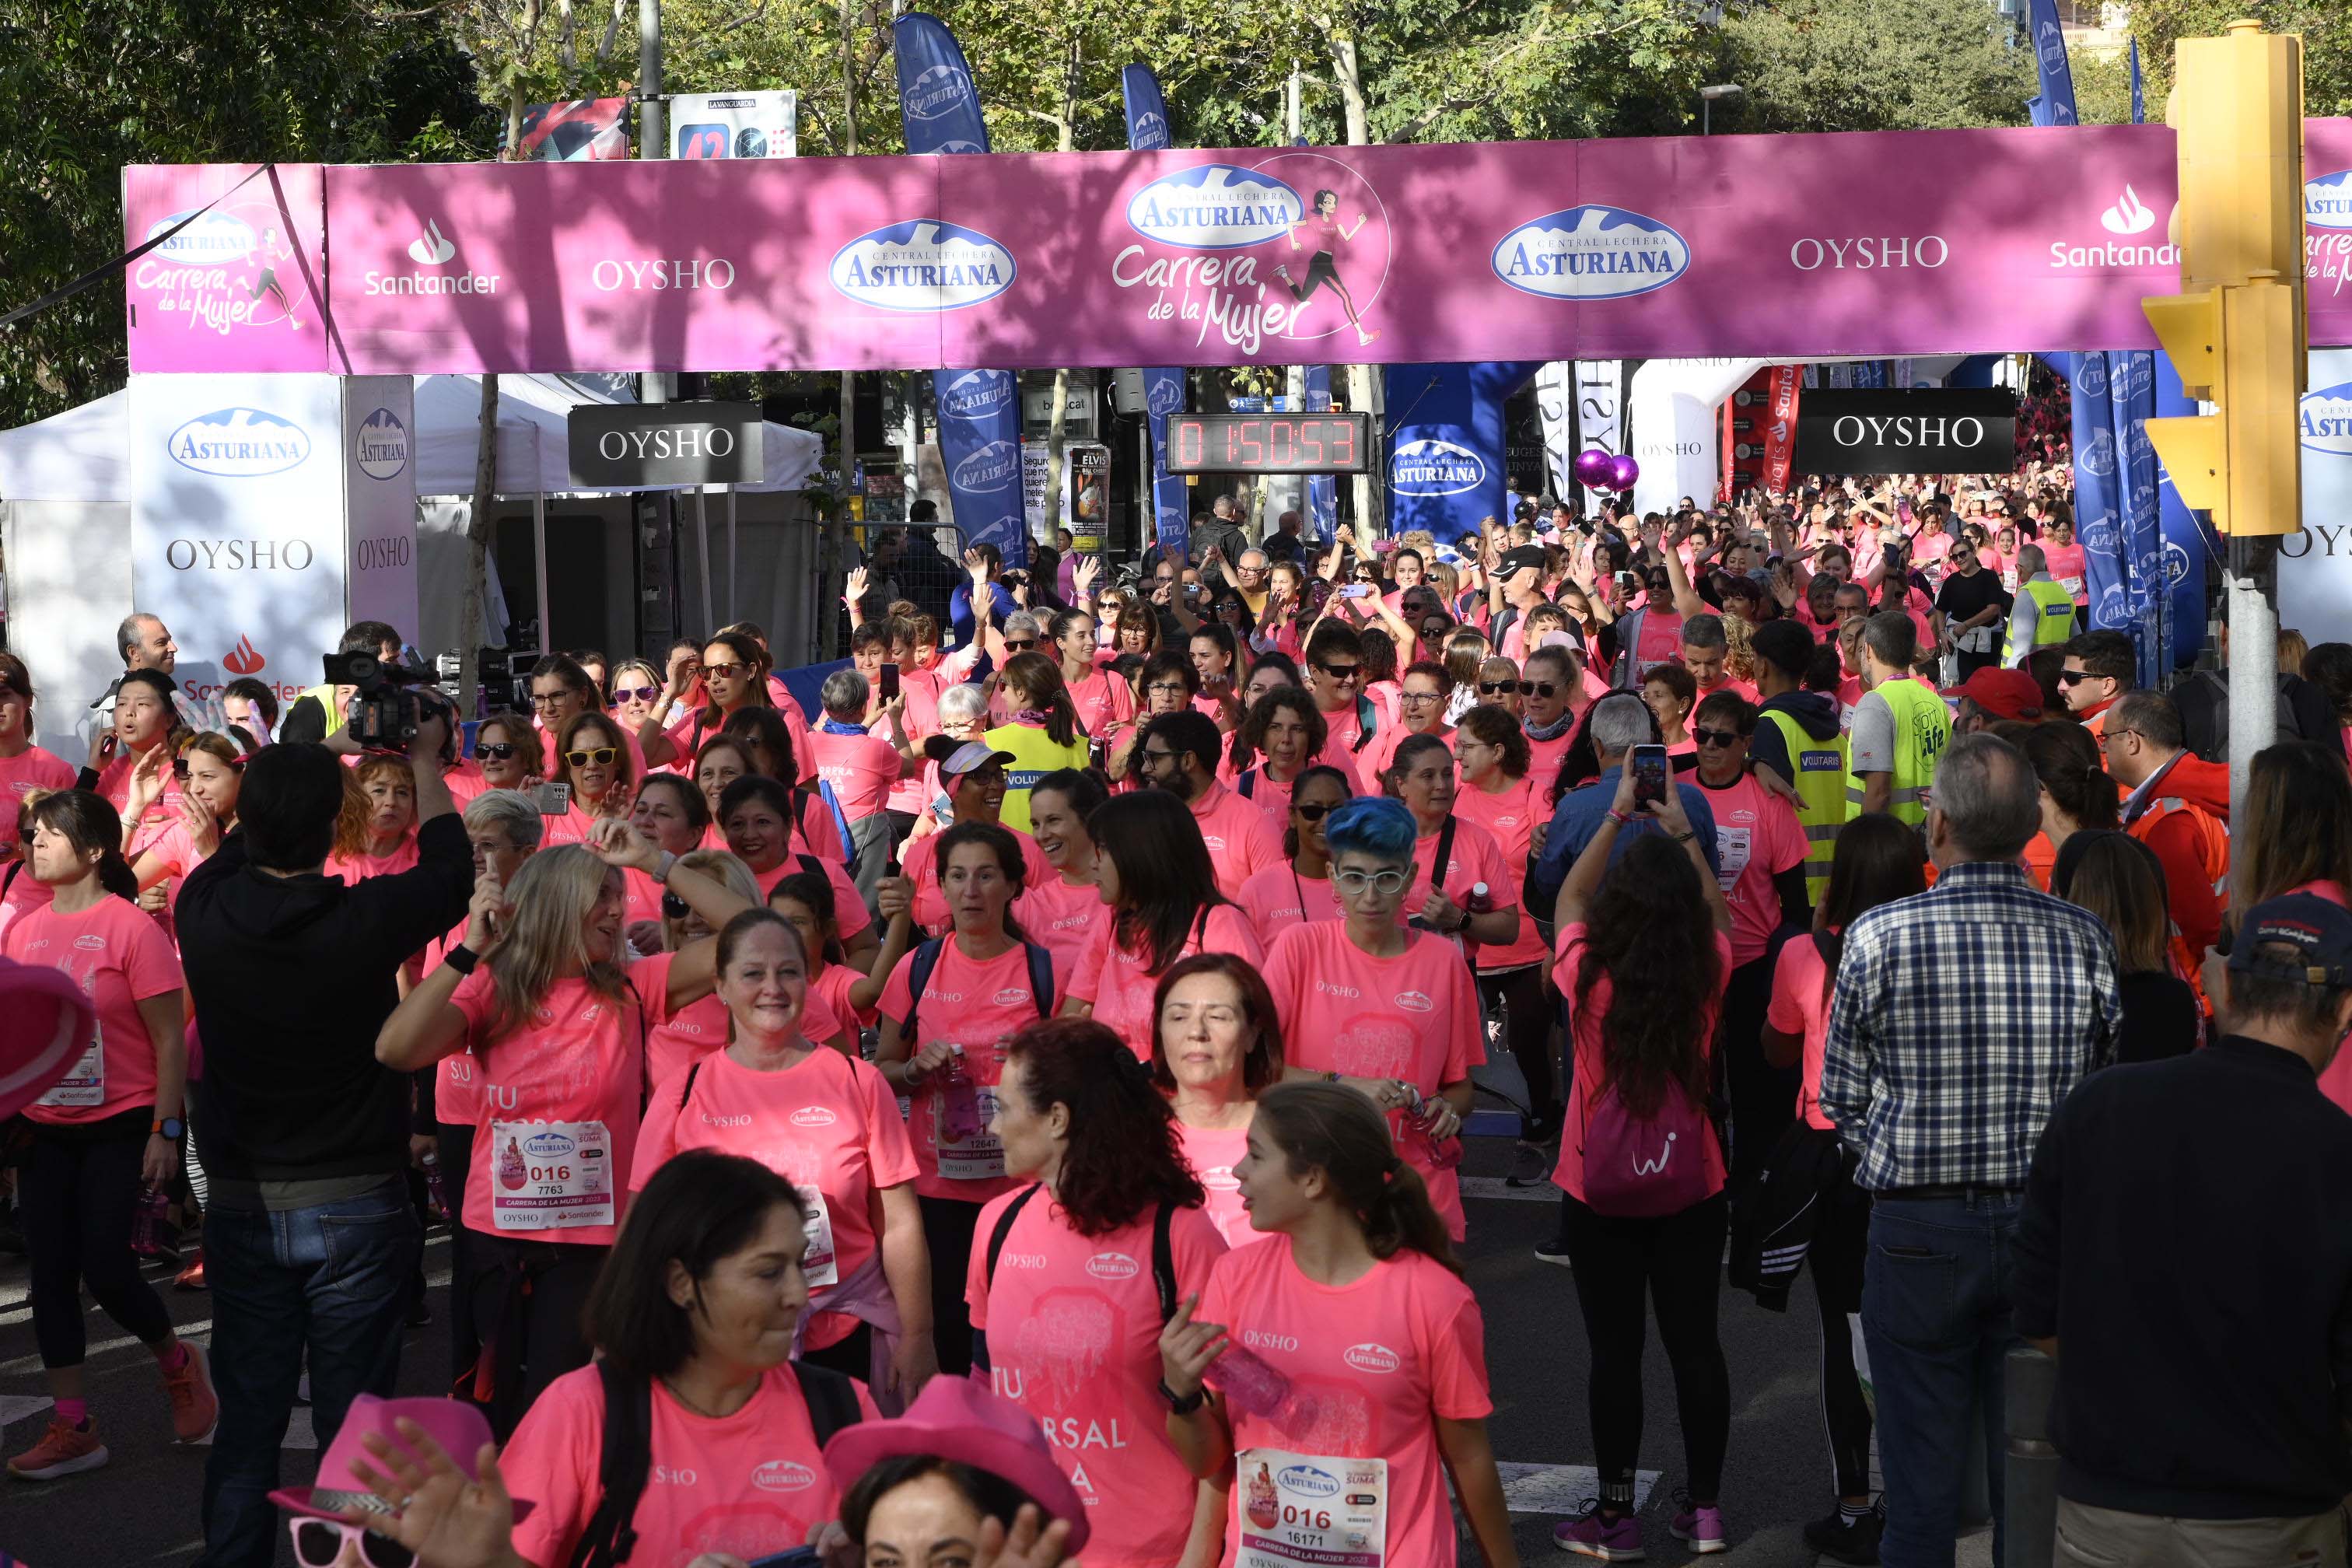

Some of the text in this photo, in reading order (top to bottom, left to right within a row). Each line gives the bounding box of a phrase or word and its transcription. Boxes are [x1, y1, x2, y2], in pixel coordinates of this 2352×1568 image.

[1229, 191, 1285, 201] LECHERA
[1140, 196, 1290, 228] ASTURIANA
[1538, 236, 1668, 247] CENTRAL LECHERA
[1790, 236, 1948, 270] OYSHO
[872, 250, 996, 261] CENTRAL LECHERA
[1112, 244, 1257, 289] Carrera
[1507, 242, 1674, 276] ASTURIANA
[2322, 256, 2337, 278] la
[135, 261, 227, 290] Carrera
[365, 270, 500, 295] Santander
[592, 258, 735, 291] OYSHO
[845, 260, 1002, 289] ASTURIANA
[158, 288, 262, 335] de la Mujer
[1147, 282, 1311, 355] de la Mujer
[1833, 415, 1984, 448] OYSHO
[180, 433, 299, 459] ASTURIANA
[360, 442, 405, 462] ASTURIANA
[600, 428, 733, 460] OYSHO
[1083, 455, 1106, 465] ELVIS
[1390, 465, 1477, 484] ASTURIANA
[166, 539, 313, 571] OYSHO
[358, 536, 409, 571] OYSHO
[184, 680, 306, 702] Sander
[550, 832, 580, 842] OYSHO
[1052, 914, 1089, 931] OYSHO
[1271, 908, 1307, 919] OYSHO
[996, 992, 1027, 1003] ASTURIANA
[1316, 980, 1359, 999] OYSHO
[487, 1083, 516, 1110] TU
[794, 1114, 833, 1122] ASTURIANA
[527, 1143, 571, 1153] ASTURIANA
[530, 1166, 571, 1181] 016
[538, 1185, 563, 1195] 7763
[503, 1210, 604, 1223] OYSHO Santander
[1004, 1253, 1136, 1276] OYSHO ASTURIANA
[1244, 1329, 1398, 1371] OYSHO ASTURIANA
[992, 1367, 1023, 1398] TU
[1283, 1472, 1376, 1493] ASTURIANA SUMA
[1283, 1506, 1332, 1529] 016
[1287, 1531, 1323, 1547] 16171
[1255, 1539, 1289, 1556] CARRERA
[1301, 1550, 1313, 1559] LA
[1314, 1553, 1344, 1563] MUJER
